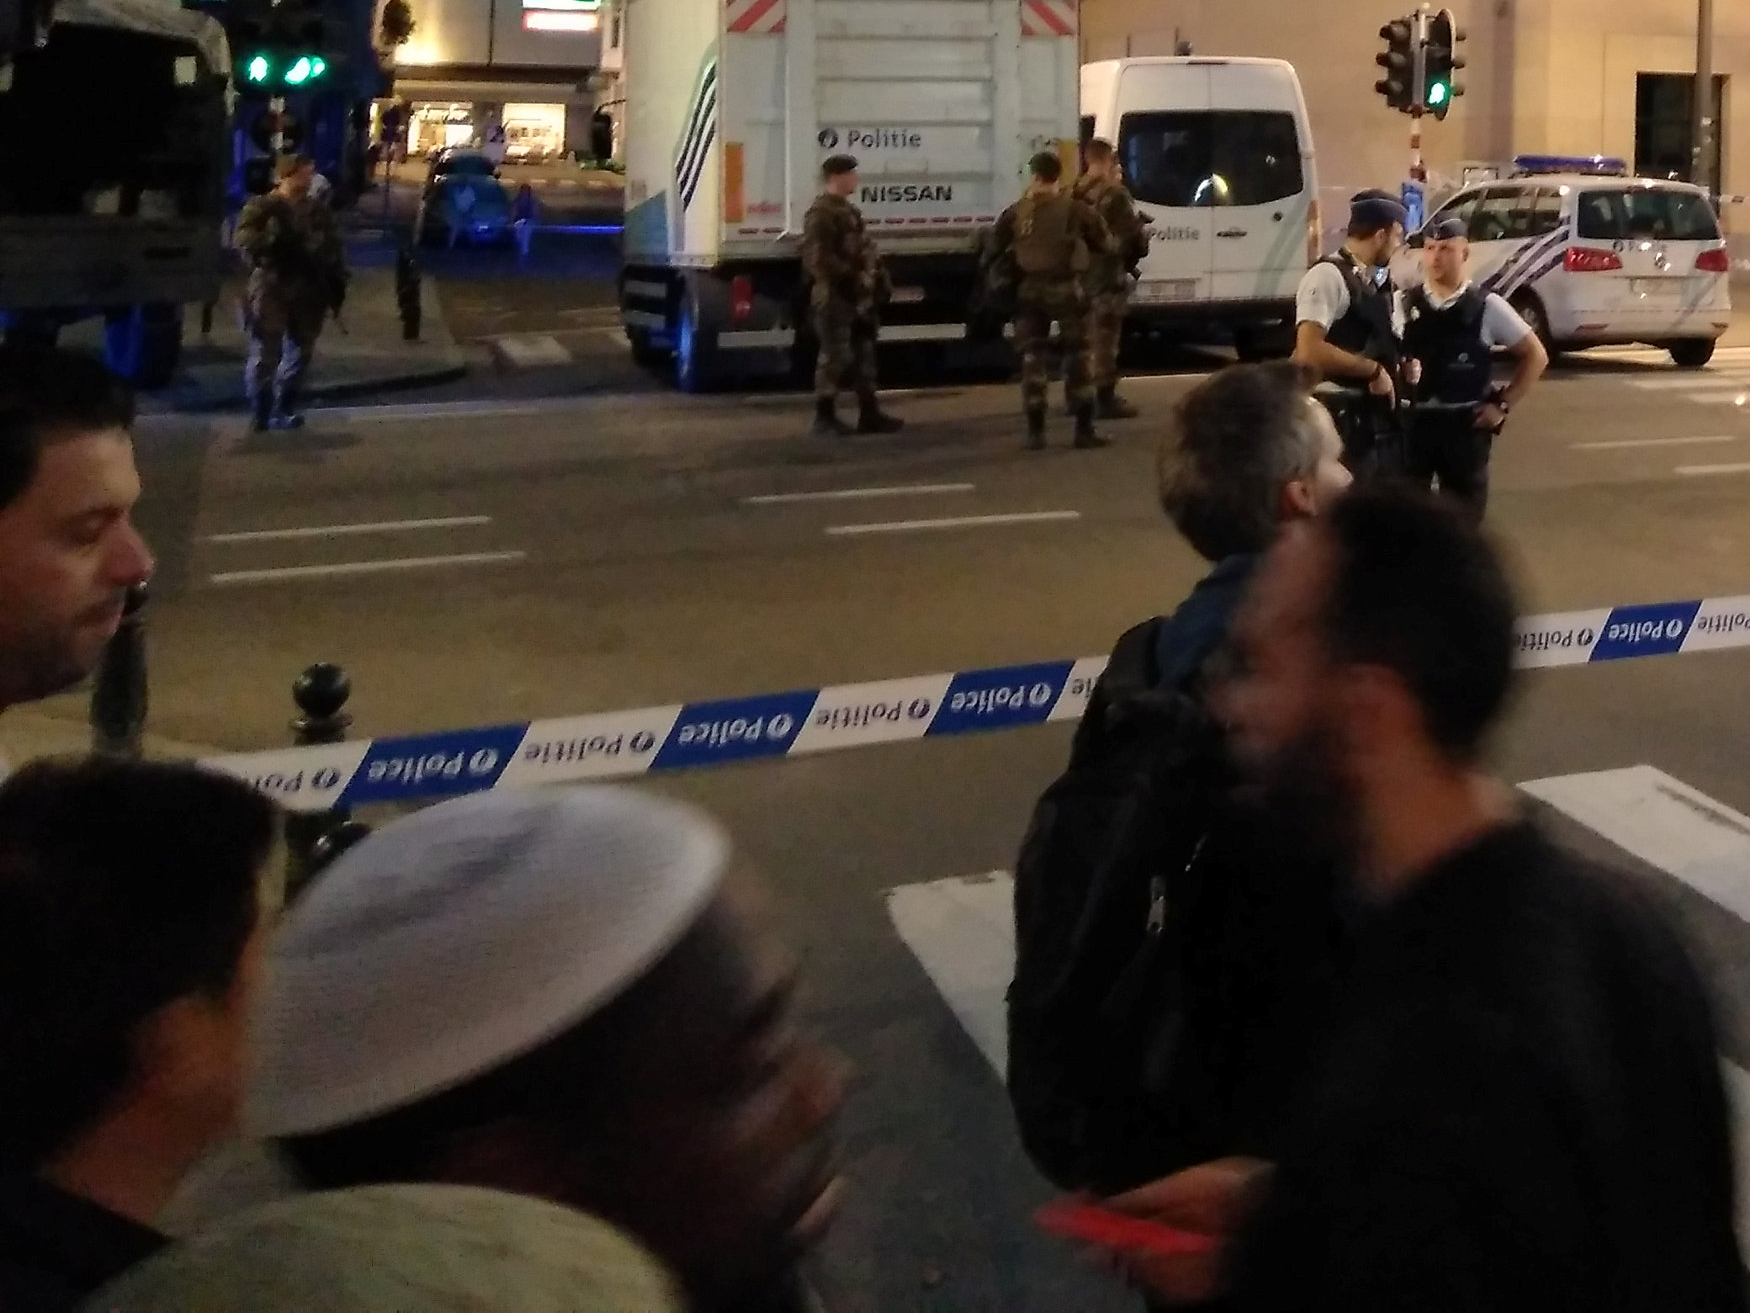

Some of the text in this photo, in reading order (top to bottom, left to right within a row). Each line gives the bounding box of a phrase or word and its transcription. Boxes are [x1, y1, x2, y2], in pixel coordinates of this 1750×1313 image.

[847, 128, 922, 148] Politie
[861, 185, 952, 203] NISSAN
[1609, 620, 1665, 642] Police
[368, 684, 1024, 785] Police Politie Police Politie Police
